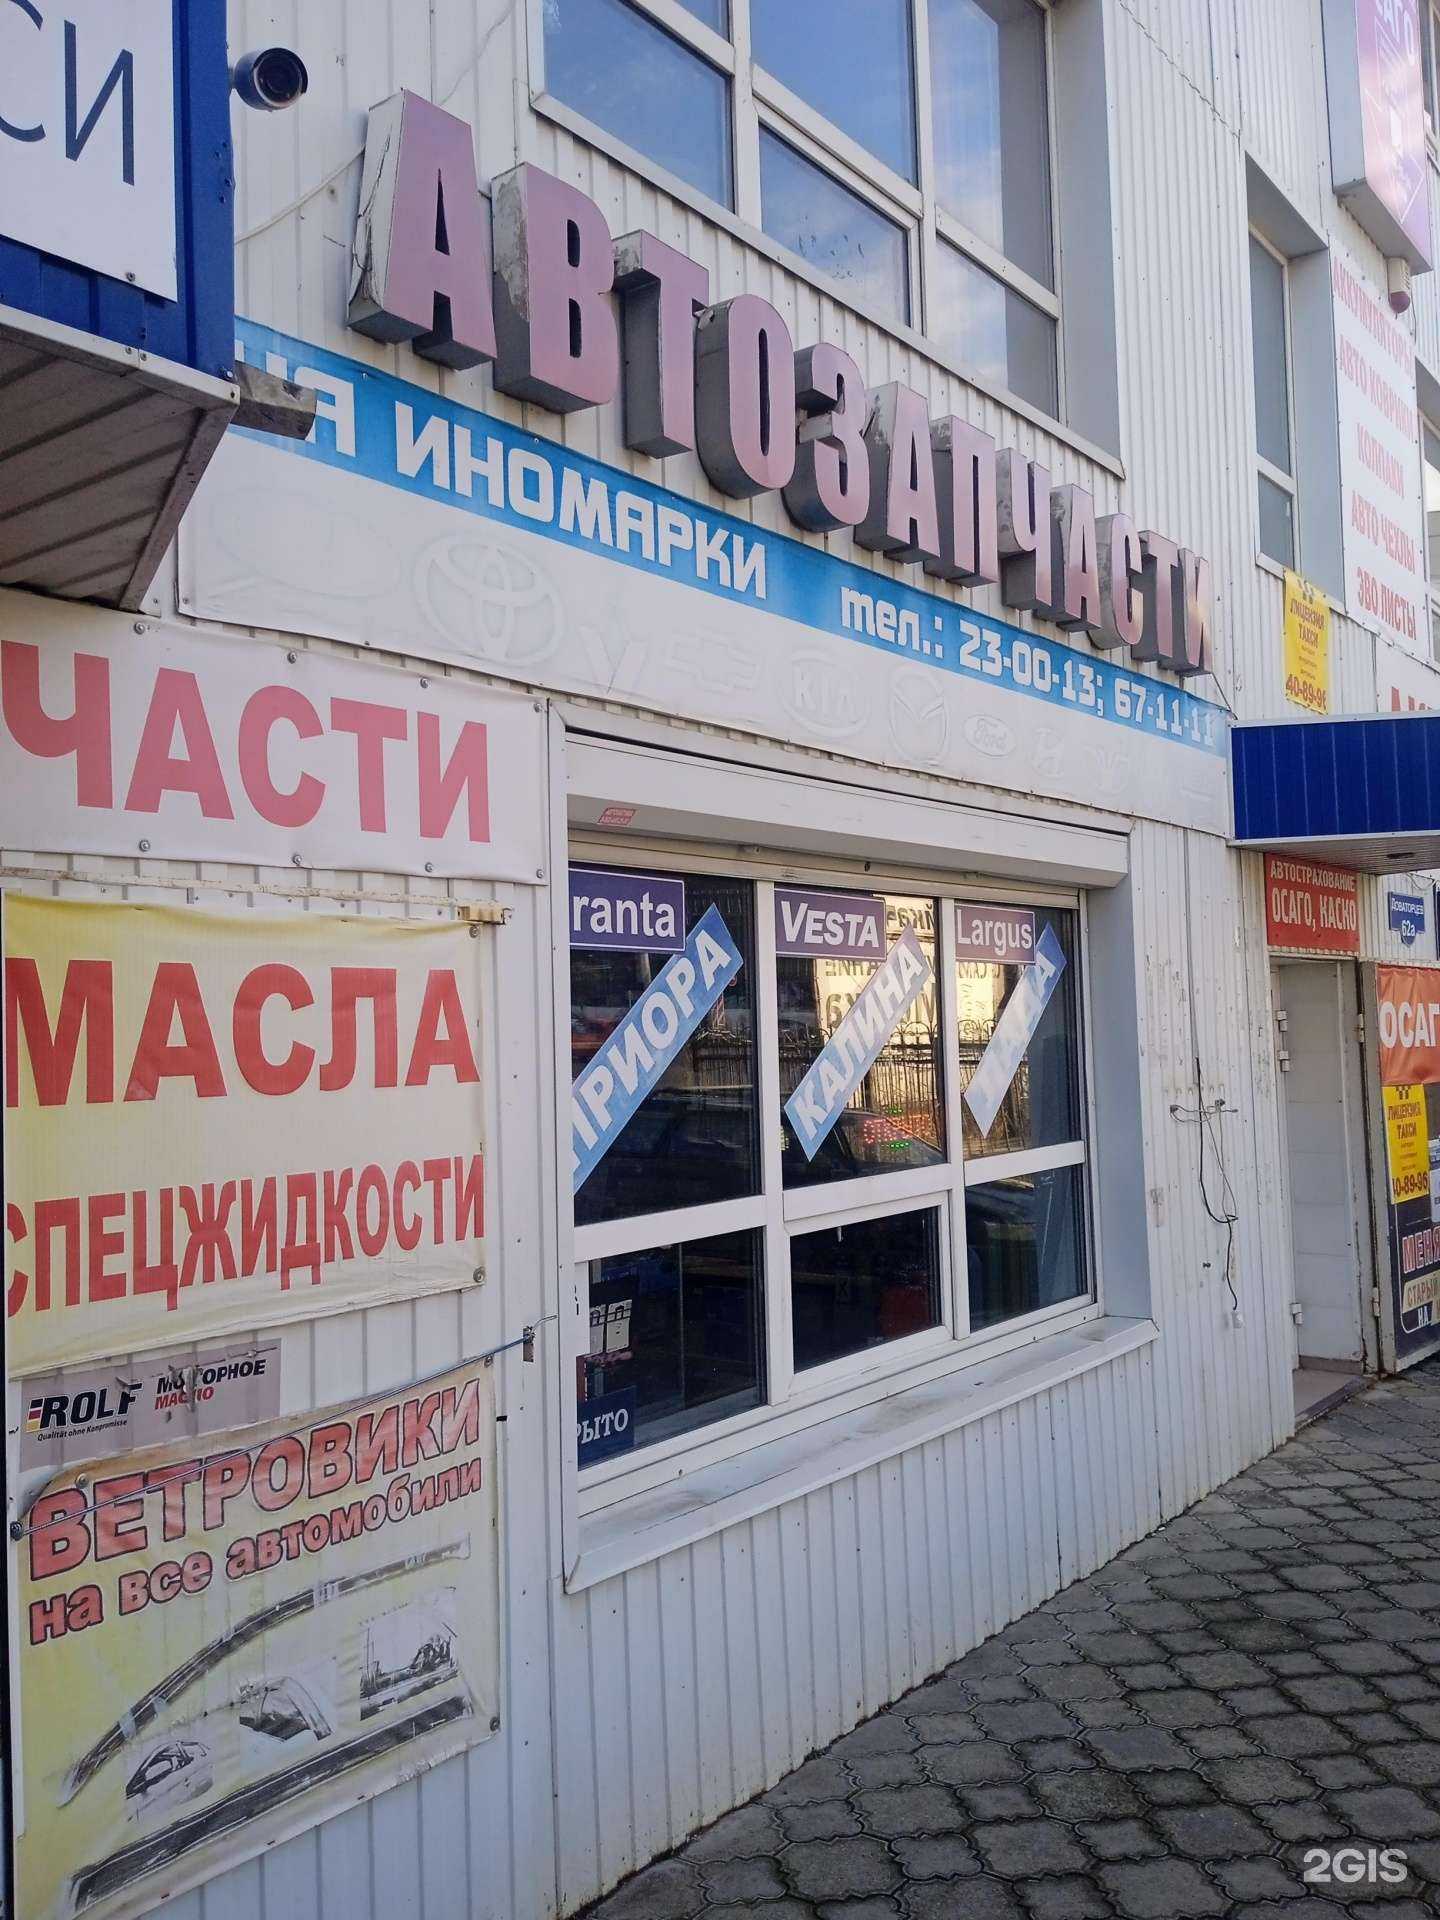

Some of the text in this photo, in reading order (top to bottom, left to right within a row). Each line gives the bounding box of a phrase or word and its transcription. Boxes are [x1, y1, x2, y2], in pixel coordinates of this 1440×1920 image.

[349, 88, 1214, 677] АВТОЗАПЧАСТИ
[1351, 490, 1415, 574] АВТО ЧЕХЛЫ
[395, 400, 767, 600] ИНОМАРКИ
[959, 623, 1104, 717] 23-00-13;
[1114, 678, 1216, 746] 67-11-11
[1299, 623, 1318, 648] ТАКСИ
[1381, 583, 1417, 641] ЛИСТЫ
[1, 640, 491, 843] ЧАСТИ
[1271, 860, 1356, 892] АВТОСТРАХОВАНИЕ
[780, 900, 880, 948] VESTA
[956, 909, 1033, 955] Largus
[1272, 887, 1357, 932] ОСАГО, КАСКО
[4, 957, 480, 1108] МАСЛА
[793, 943, 924, 1139] КАЛИНА
[1379, 1001, 1440, 1049] ОСАГ
[1396, 1122, 1417, 1140] ТАКСИ
[156, 1359, 267, 1395] МООРНОЕ
[39, 1382, 143, 1430] ROLF
[68, 1427, 85, 1437] ohne
[30, 1378, 481, 1582] ВЕТРОВИКИ
[30, 1456, 482, 1645] на все автомобили
